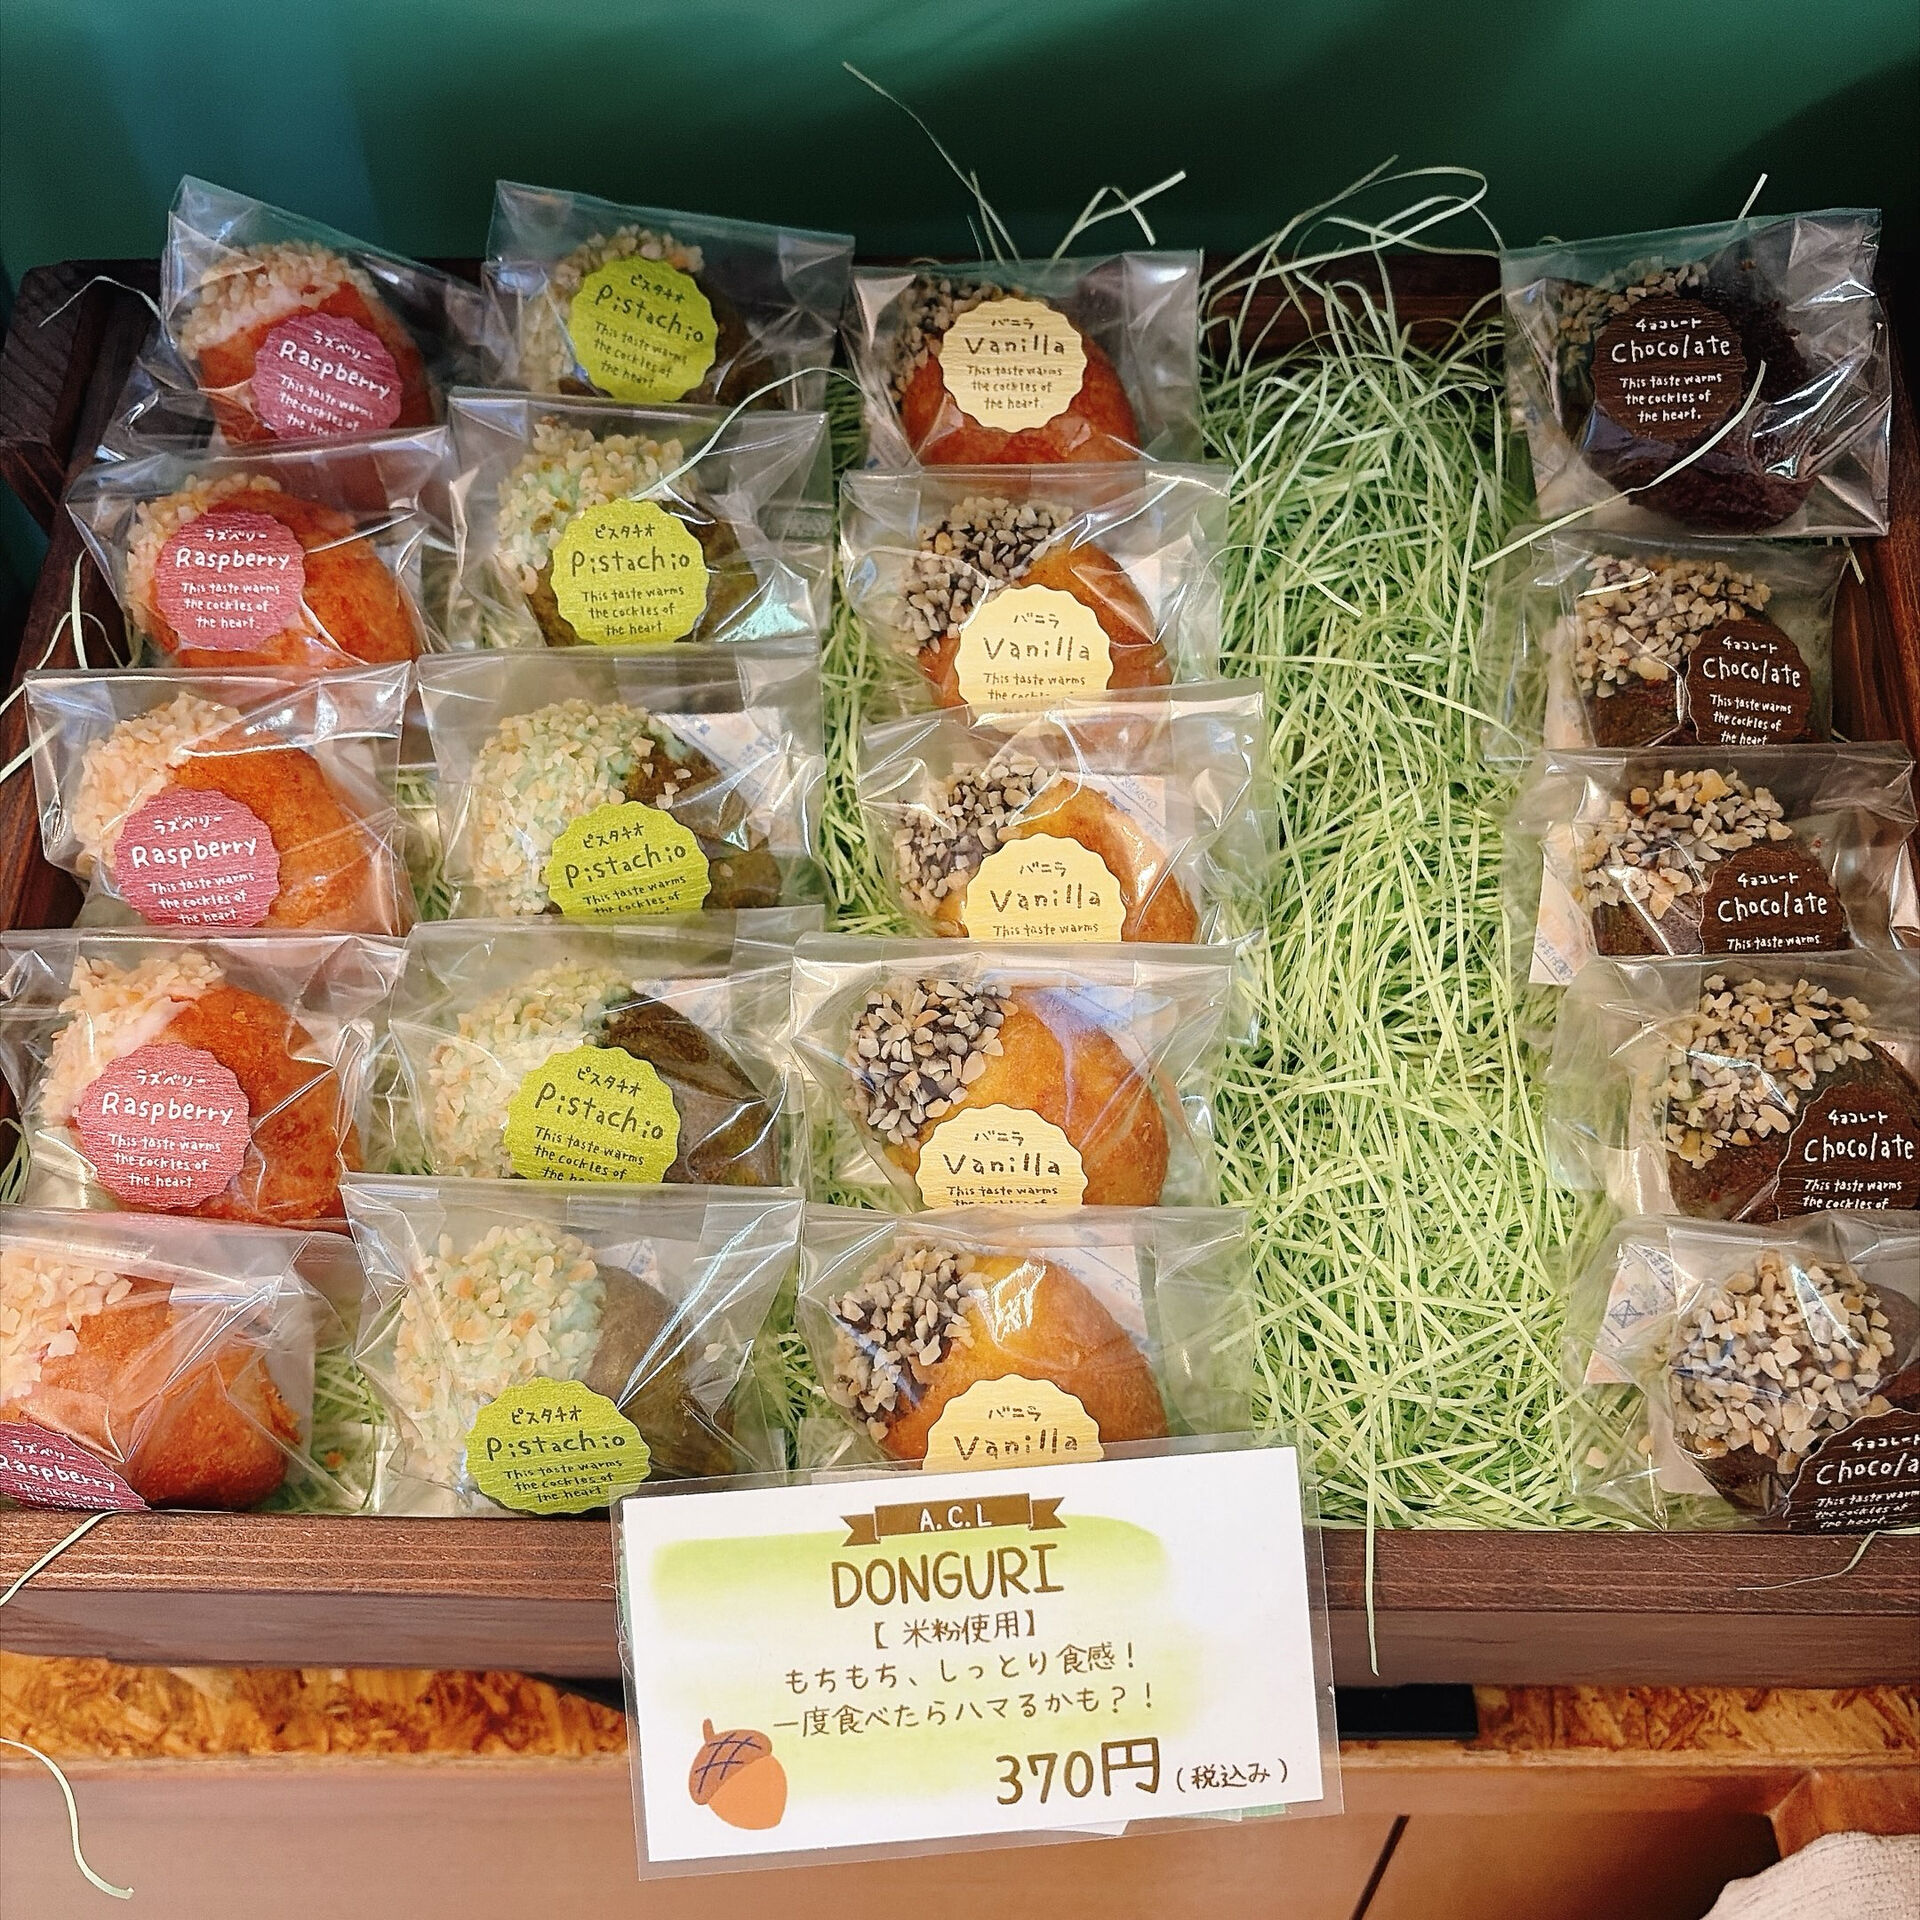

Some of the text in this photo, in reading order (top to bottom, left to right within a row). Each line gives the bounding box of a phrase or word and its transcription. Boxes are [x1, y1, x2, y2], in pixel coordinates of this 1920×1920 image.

[594, 284, 703, 342] Pistachio
[991, 319, 1034, 330] バニラ
[596, 321, 688, 365] This taste warms
[965, 335, 1064, 355] Vanilla
[1611, 334, 1730, 362] Chocolate
[594, 340, 672, 377] the of
[600, 361, 618, 375] the
[280, 340, 391, 399] Raspberry
[966, 365, 1062, 376] This taste warms
[971, 381, 1052, 393] the cockles of
[1620, 373, 1722, 389] This taste warms
[984, 397, 1002, 409] the
[1625, 390, 1711, 405] the cockles of
[1637, 407, 1700, 423] the heart.
[175, 547, 290, 573] Raspberry
[572, 546, 690, 577] Pistachio
[181, 583, 280, 594] This taste warms
[582, 586, 684, 603] This taste warms
[184, 599, 269, 612] the cockles of
[589, 603, 675, 619] the cockles of
[196, 616, 216, 628] the
[1014, 612, 1059, 628] バニラ
[606, 624, 624, 636] the
[983, 636, 1089, 661] Vanilla
[983, 673, 1085, 685] This taste warms
[1703, 656, 1800, 687] Chocolate
[988, 690, 1007, 700] the
[1709, 694, 1791, 714] This taste warms
[1714, 711, 1781, 732] the cockles of
[1721, 731, 1736, 743] the
[131, 837, 256, 869] Raspberry
[565, 844, 686, 888] Pistachio
[1020, 861, 1066, 877] バニラ
[148, 873, 255, 895] This taste warms
[583, 876, 686, 905] This taste warms
[159, 889, 247, 909] the cockles of
[618, 891, 680, 912] cockles of
[990, 883, 1100, 913] Vanilla
[1718, 891, 1827, 922] Chocolate
[178, 913, 199, 924] the
[993, 924, 1099, 938] This taste warms
[1727, 935, 1820, 951] This taste warms
[136, 1069, 206, 1087] ラズベリー
[101, 1092, 233, 1126] Raspberry
[535, 1082, 663, 1139] Pistachio
[108, 1134, 220, 1152] This taste warms
[535, 1126, 644, 1166] This taste warms
[974, 1130, 1024, 1146] バニラ
[1804, 1132, 1914, 1162] Chocolate
[114, 1152, 209, 1171] the cockles of
[534, 1145, 628, 1179] the cockles of
[943, 1153, 1060, 1176] Vanilla
[128, 1174, 149, 1186] the
[543, 1167, 564, 1180] the
[947, 1186, 1058, 1196] This taste warms
[1805, 1179, 1902, 1192] This taste warms
[1803, 1195, 1889, 1209] the cockles of
[989, 1406, 1040, 1421] バニラ
[487, 1430, 626, 1460] Pistachio
[954, 1428, 1077, 1460] Vanilla
[503, 1460, 622, 1479] This taste warms
[514, 1472, 614, 1491] the cockles of
[537, 1493, 558, 1502] the
[918, 1503, 993, 1534] A.C.L
[831, 1542, 1065, 1609] DONGURI
[995, 1737, 1160, 1805] 370円
